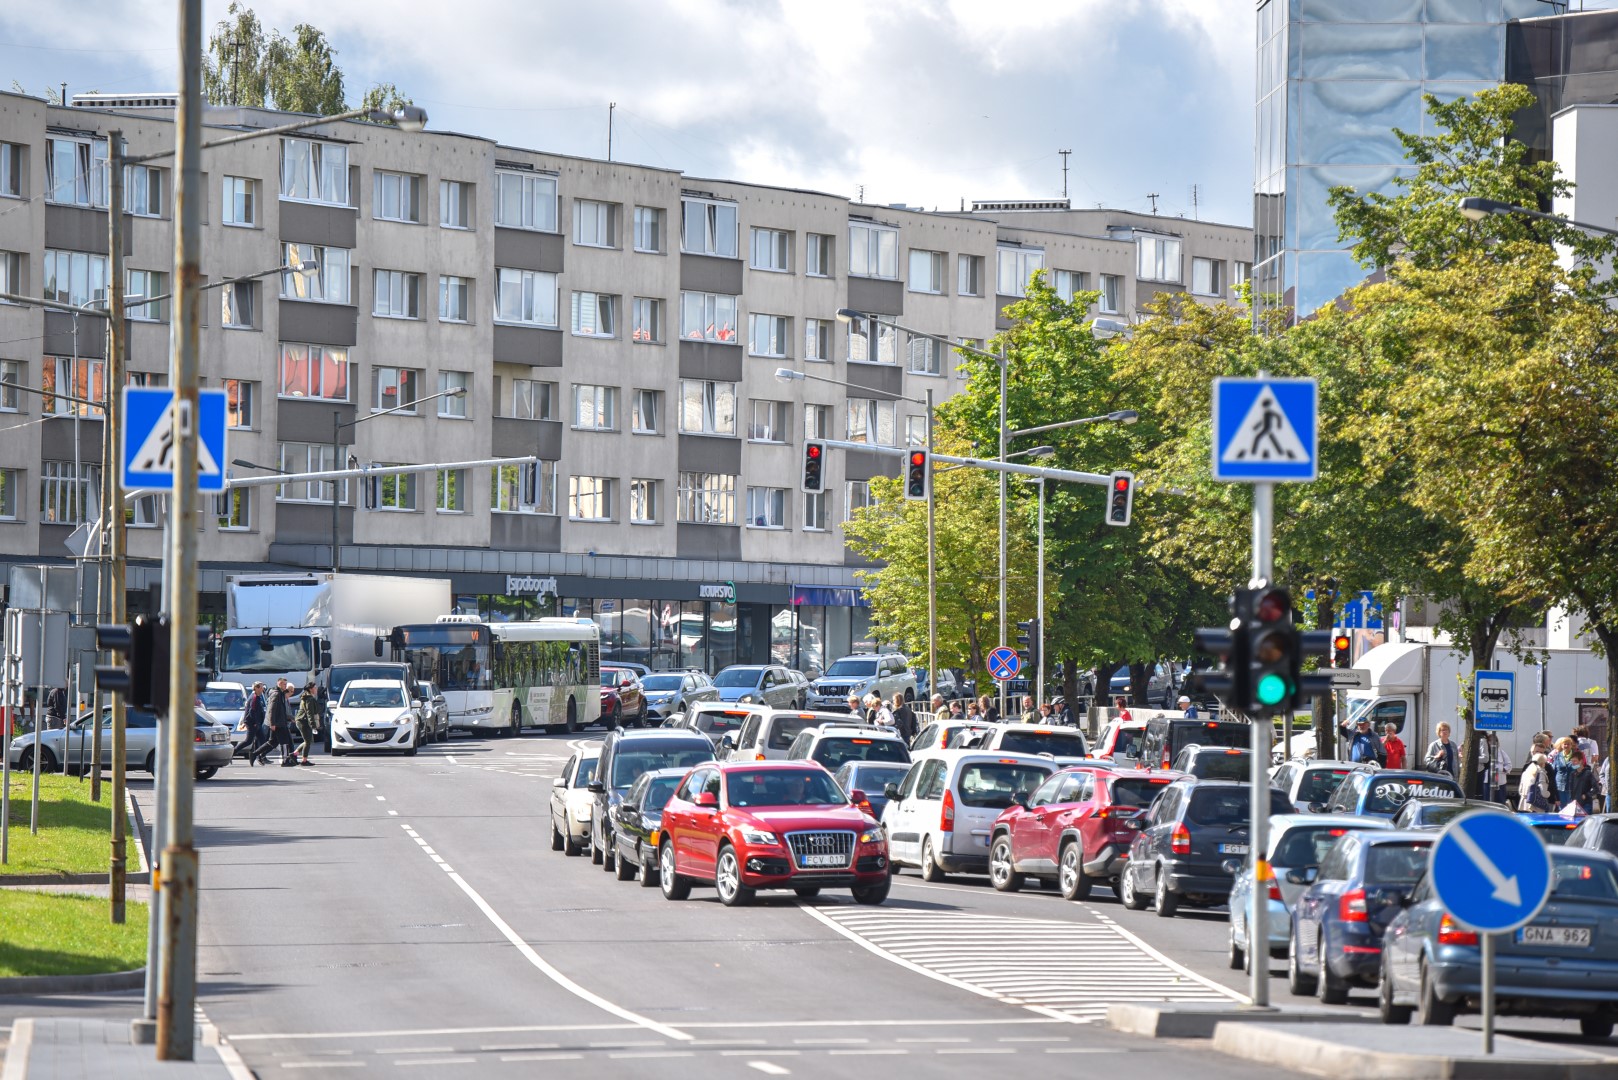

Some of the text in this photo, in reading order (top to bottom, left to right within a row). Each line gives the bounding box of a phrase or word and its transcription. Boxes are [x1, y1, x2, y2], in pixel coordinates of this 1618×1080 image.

[1409, 784, 1454, 798] Medus
[1525, 928, 1587, 943] GNA 962
